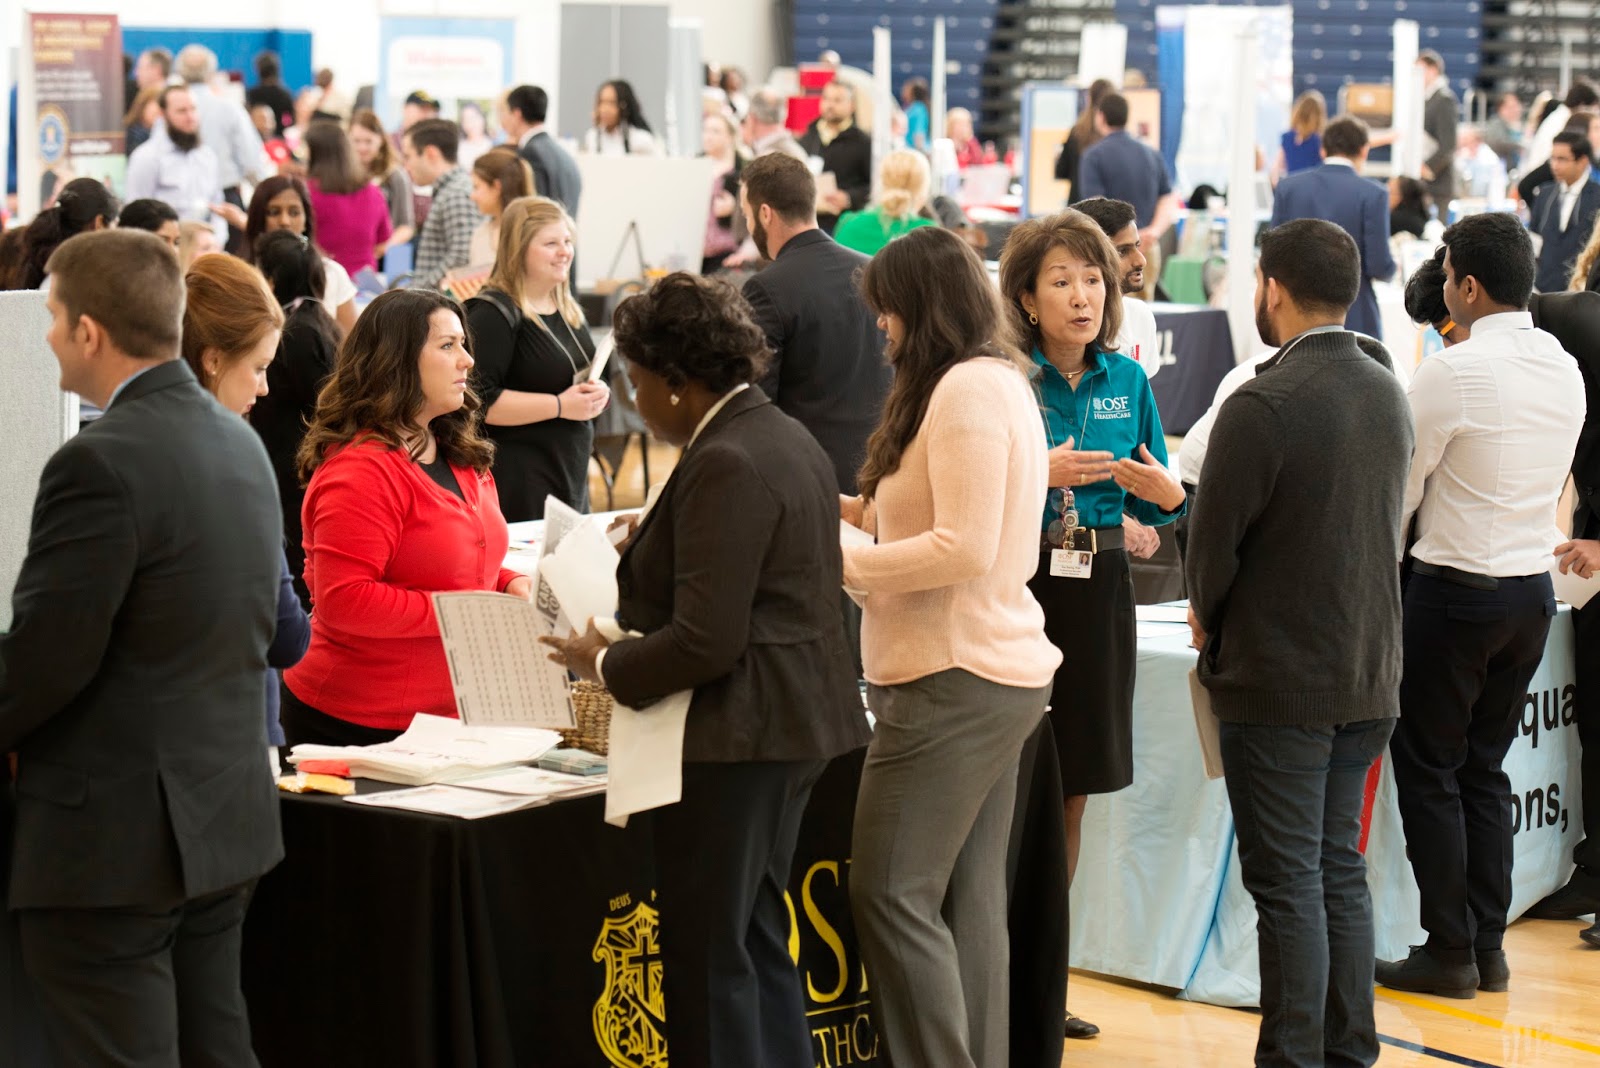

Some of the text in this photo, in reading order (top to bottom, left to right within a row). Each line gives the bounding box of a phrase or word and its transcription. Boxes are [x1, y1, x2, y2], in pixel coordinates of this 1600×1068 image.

[1102, 395, 1130, 411] OSF
[1515, 683, 1577, 749] qua
[609, 892, 632, 911] DEUS
